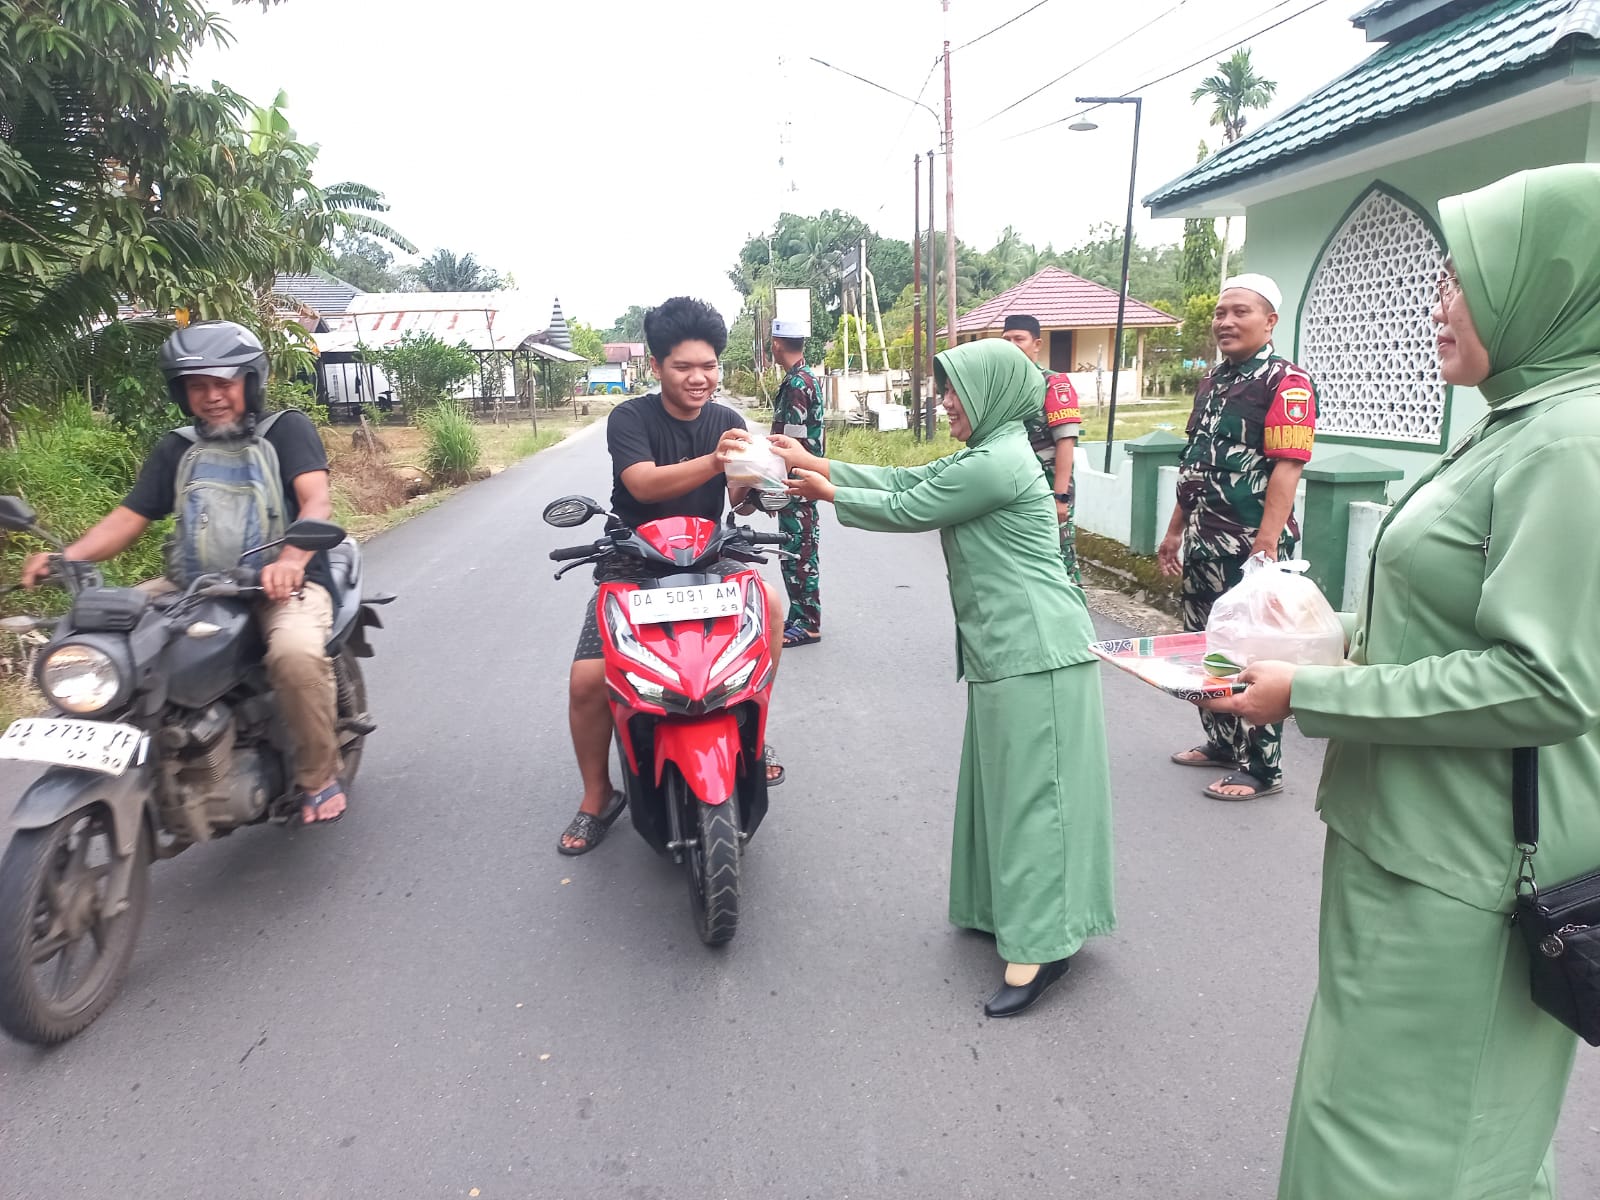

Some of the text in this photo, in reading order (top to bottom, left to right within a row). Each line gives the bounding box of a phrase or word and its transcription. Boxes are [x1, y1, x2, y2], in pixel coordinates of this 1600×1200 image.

[1047, 408, 1081, 424] BABINS
[1265, 425, 1315, 452] BABINS
[633, 586, 737, 606] DA 5091 AM
